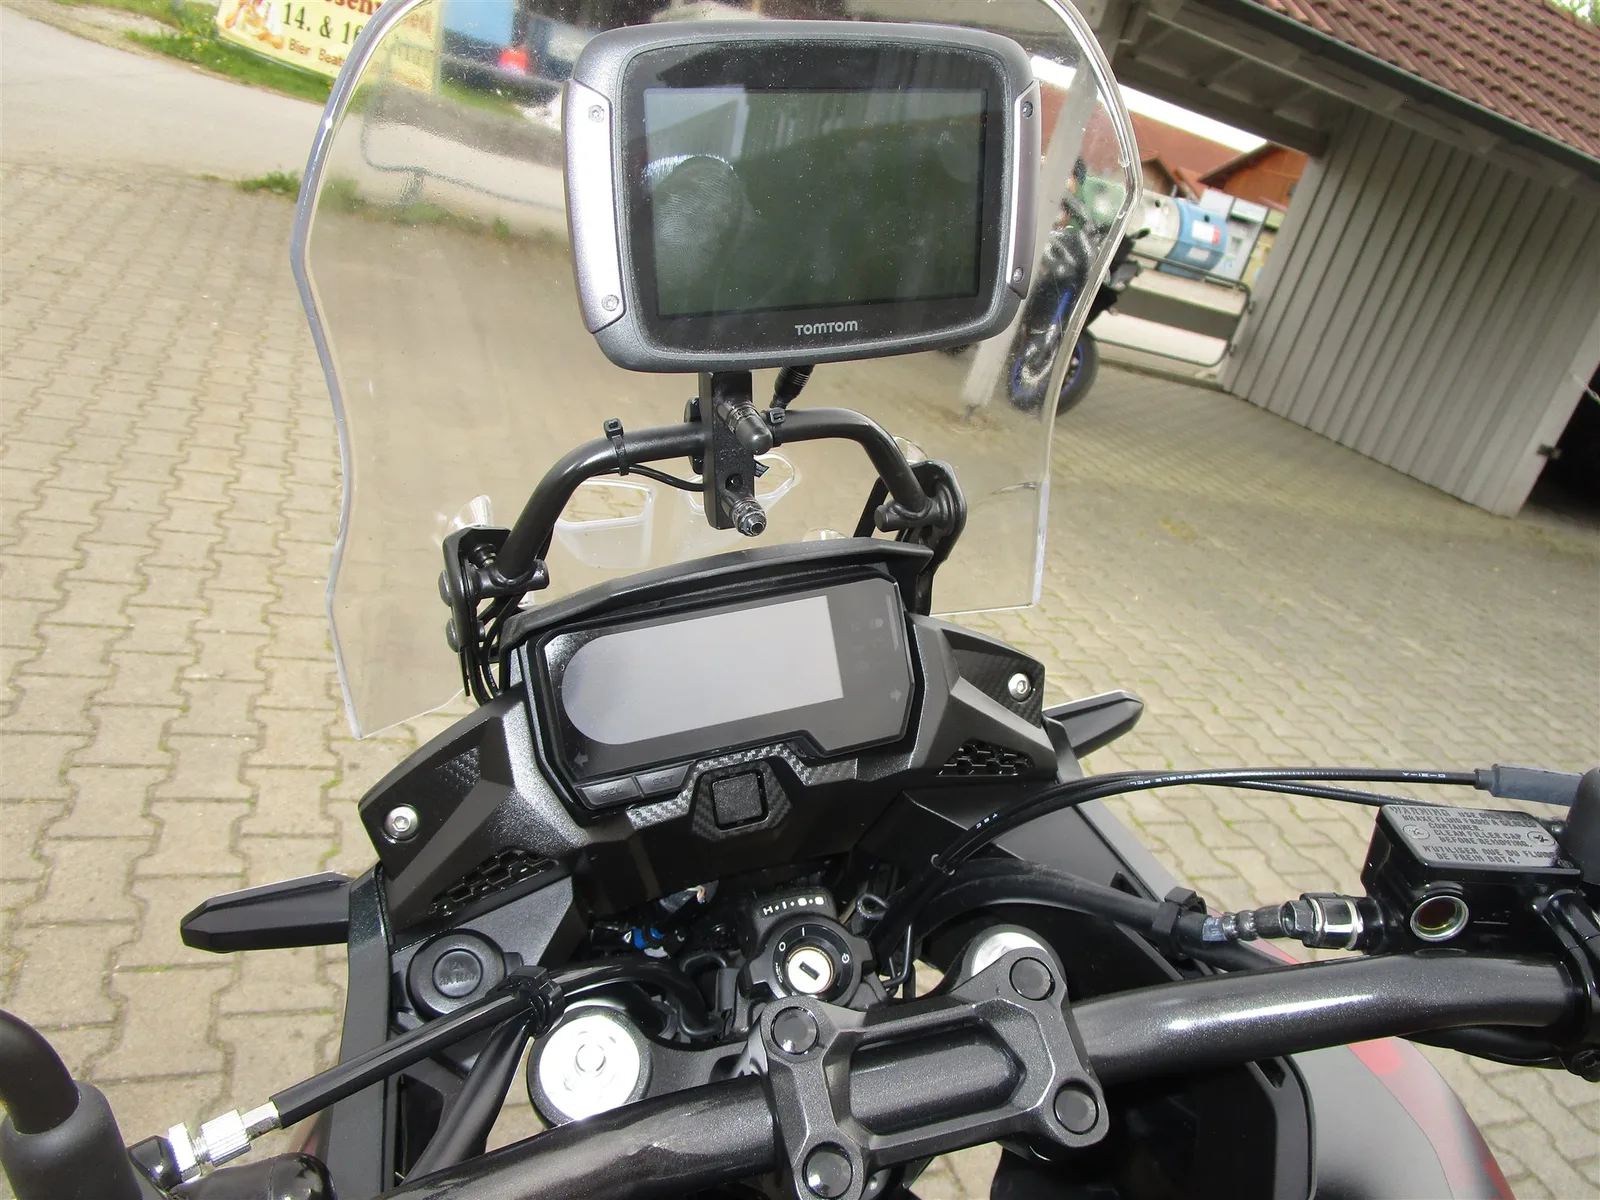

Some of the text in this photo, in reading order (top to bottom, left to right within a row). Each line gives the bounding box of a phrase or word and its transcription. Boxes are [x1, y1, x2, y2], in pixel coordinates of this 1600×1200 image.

[284, 3, 311, 32] 14.
[319, 15, 331, 39] &
[288, 38, 311, 56] Bier
[1435, 816, 1462, 824] FLUID
[1462, 818, 1490, 826] FROM
[1433, 829, 1521, 840] CLEAN FILLER CAP
[1438, 836, 1478, 845] BEFORE
[1422, 845, 1479, 854] N'UTILISER
[1481, 848, 1503, 856] QUE
[1504, 849, 1521, 857] DU
[1435, 852, 1451, 860] DE
[1452, 854, 1485, 862] FREIN
